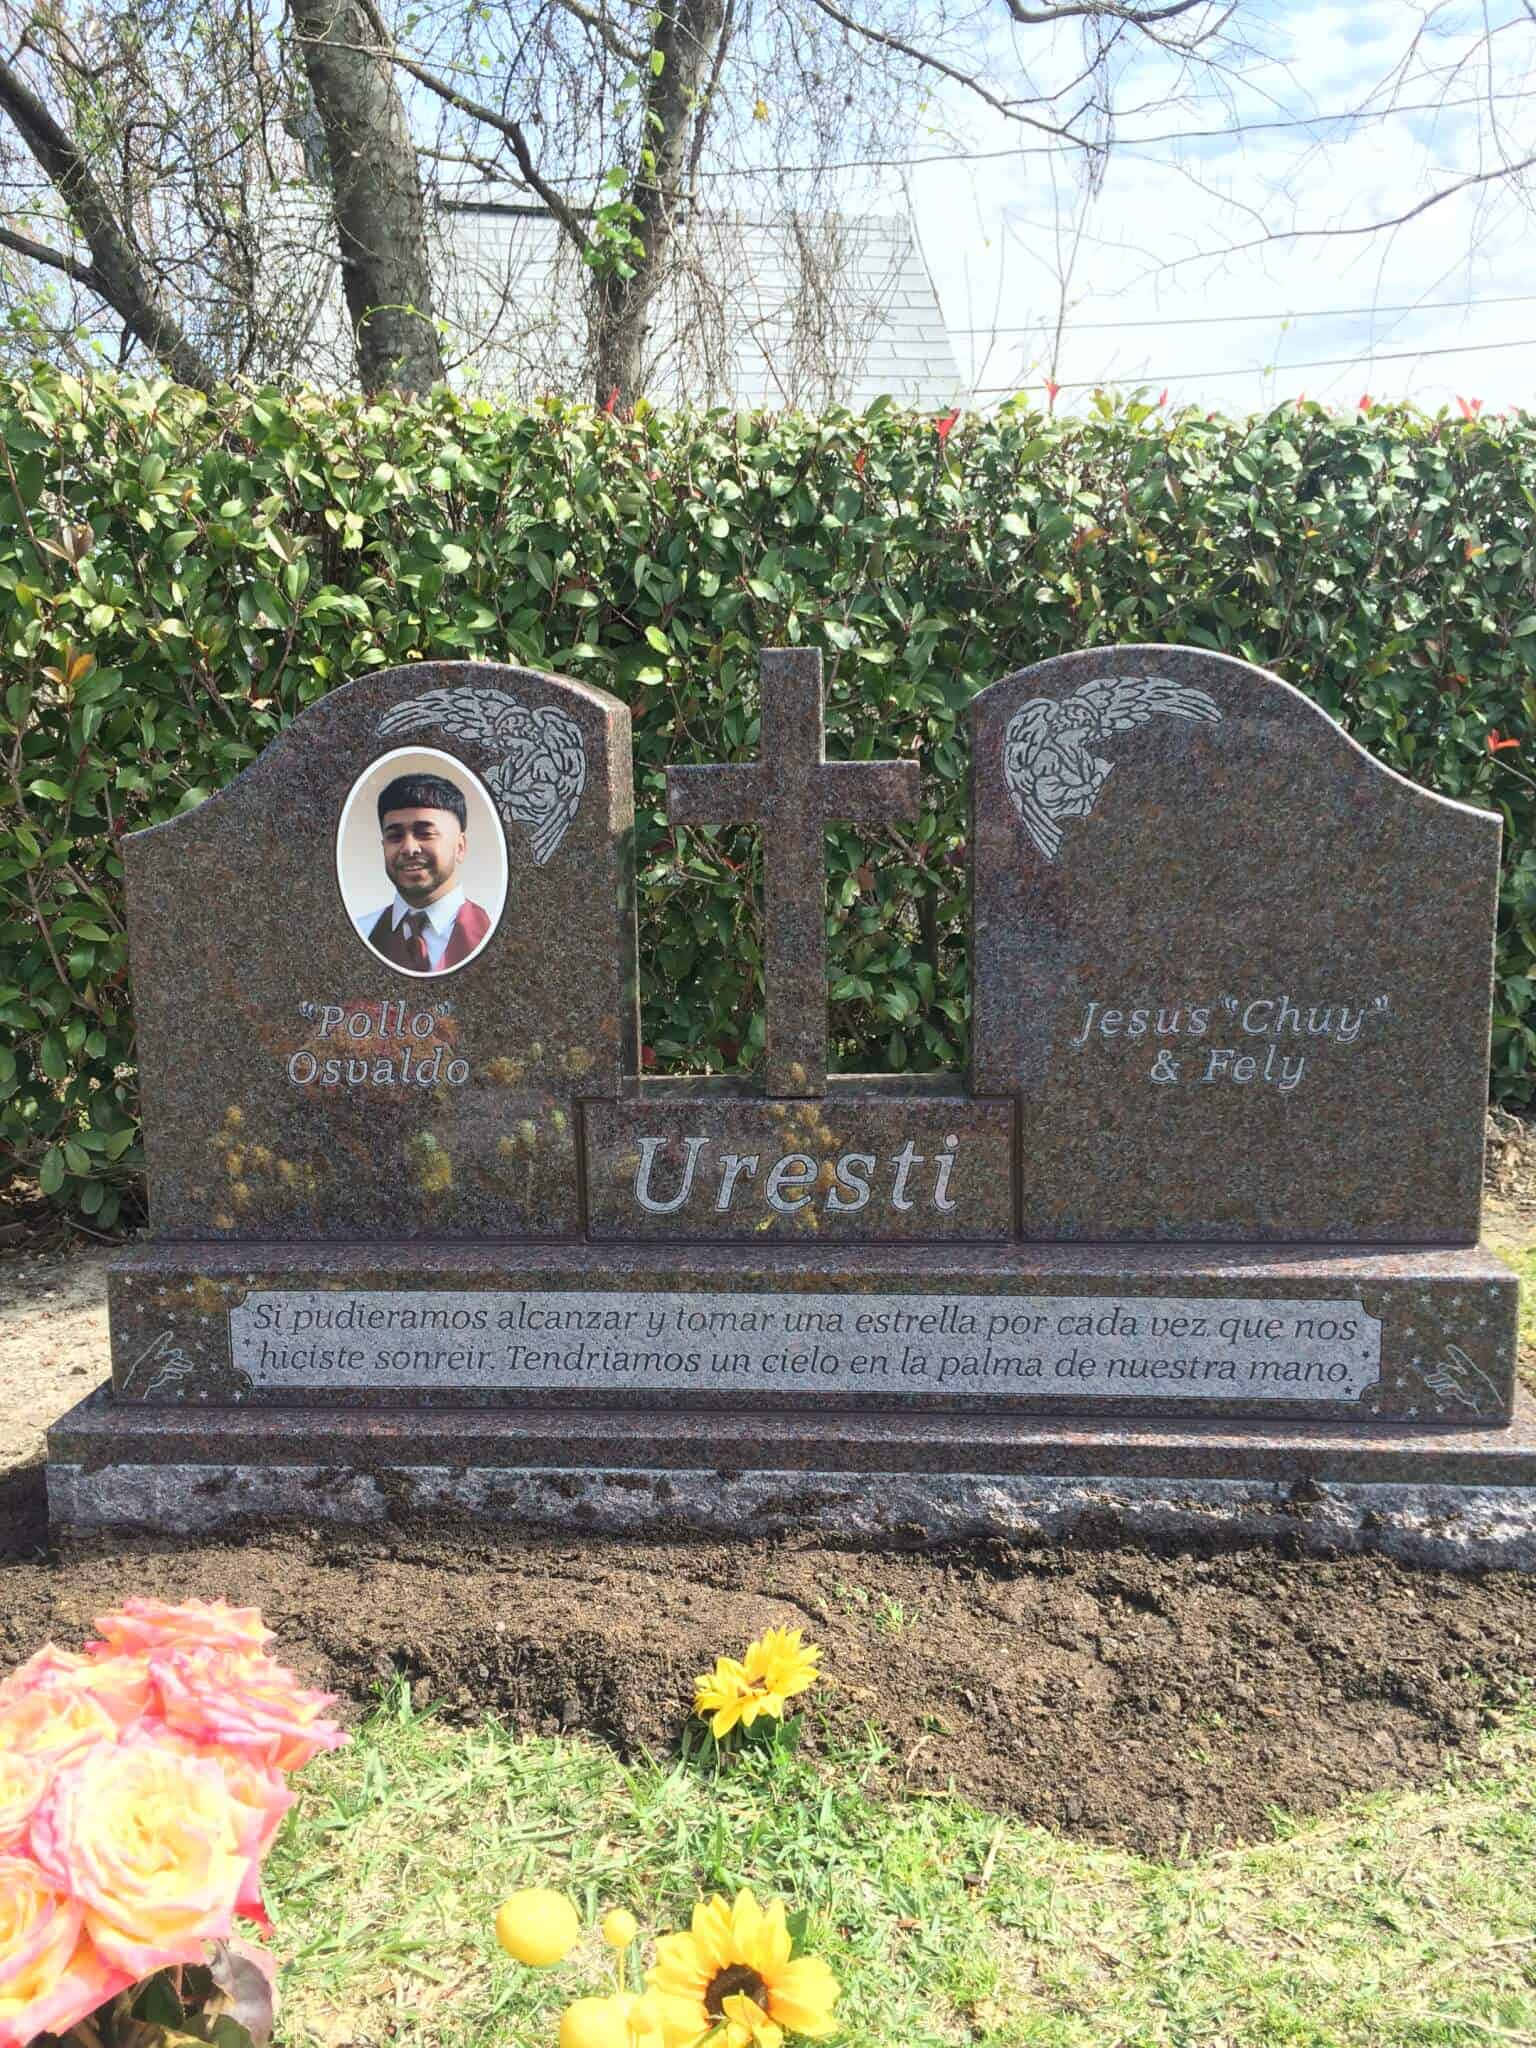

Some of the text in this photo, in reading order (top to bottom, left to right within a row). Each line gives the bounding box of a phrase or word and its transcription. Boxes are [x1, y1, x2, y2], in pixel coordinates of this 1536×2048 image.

[1072, 1002, 1211, 1046] Jesus
[288, 1046, 470, 1086] Osvaldo
[1151, 1044, 1305, 1090] & Fely
[635, 1134, 960, 1213] Uresti
[254, 1301, 1358, 1346] Si pudieramos alcanzar y tomar una estrella por cada vez que nos
[259, 1342, 1355, 1383] hiciste sonreir. Tendriamos un cielo en la palma de nuestra mano.
